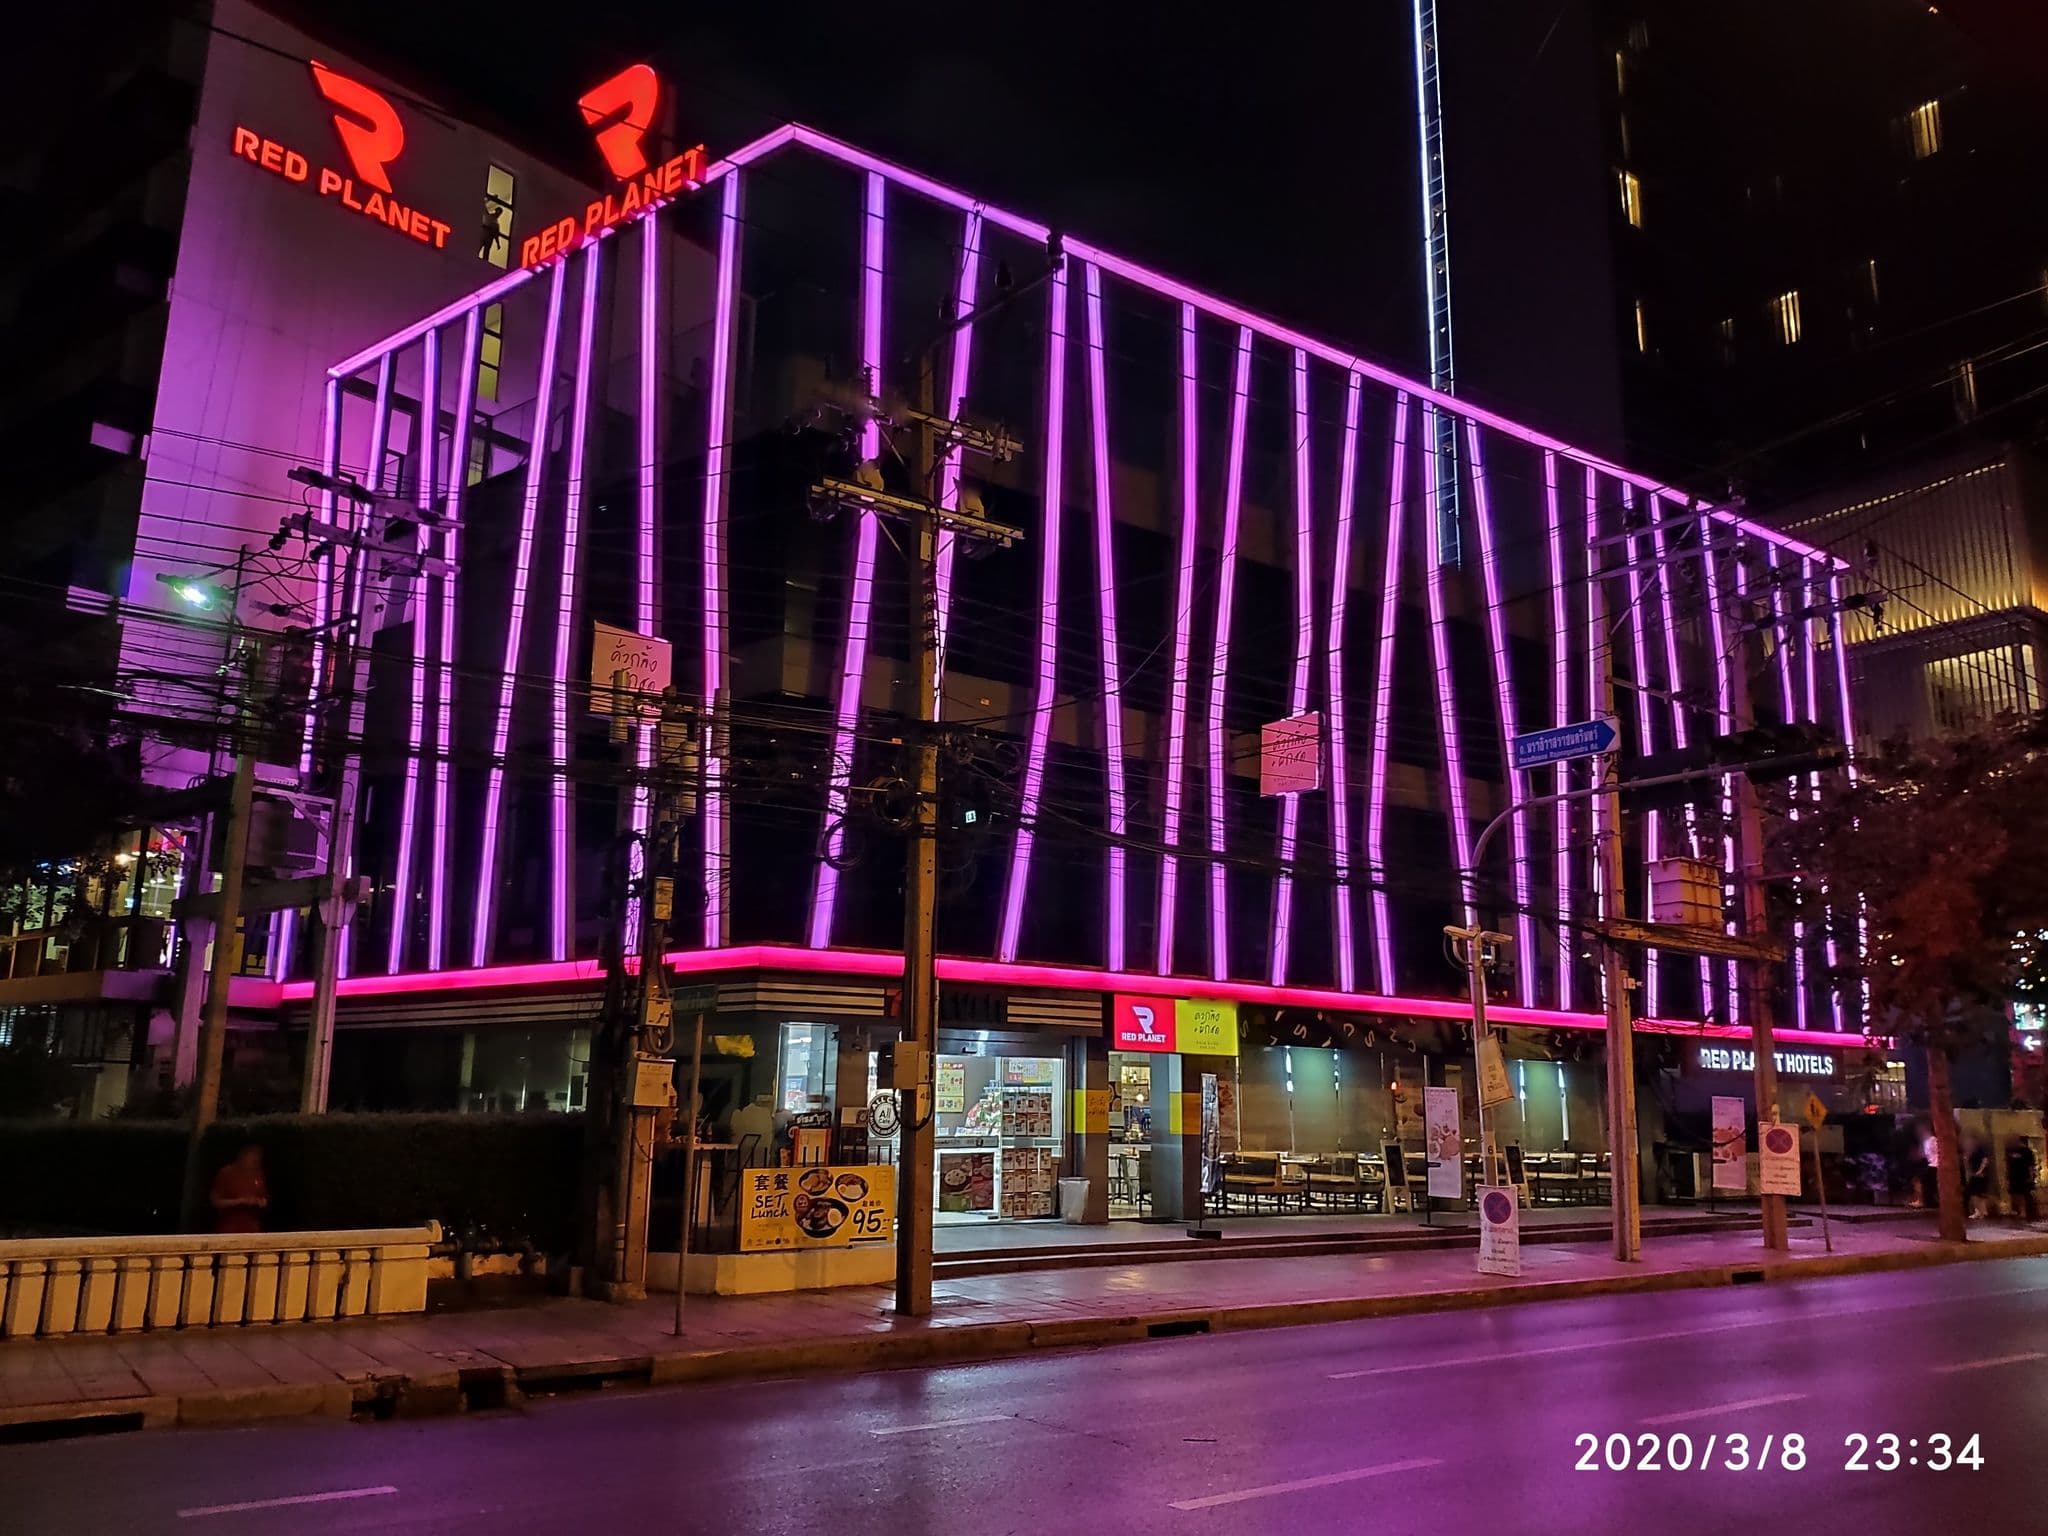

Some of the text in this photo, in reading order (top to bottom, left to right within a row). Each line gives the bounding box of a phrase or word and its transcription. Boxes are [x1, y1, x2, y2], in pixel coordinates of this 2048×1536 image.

[234, 127, 451, 248] RED PLANET
[522, 144, 705, 269] RED PLANET
[1121, 1032, 1167, 1043] RED PLANET
[1700, 1048, 1731, 1069] RED
[1786, 1053, 1833, 1075] HOTELS
[754, 1173, 789, 1191] 套餐
[755, 1192, 790, 1209] SET
[751, 1203, 790, 1219] Lunch
